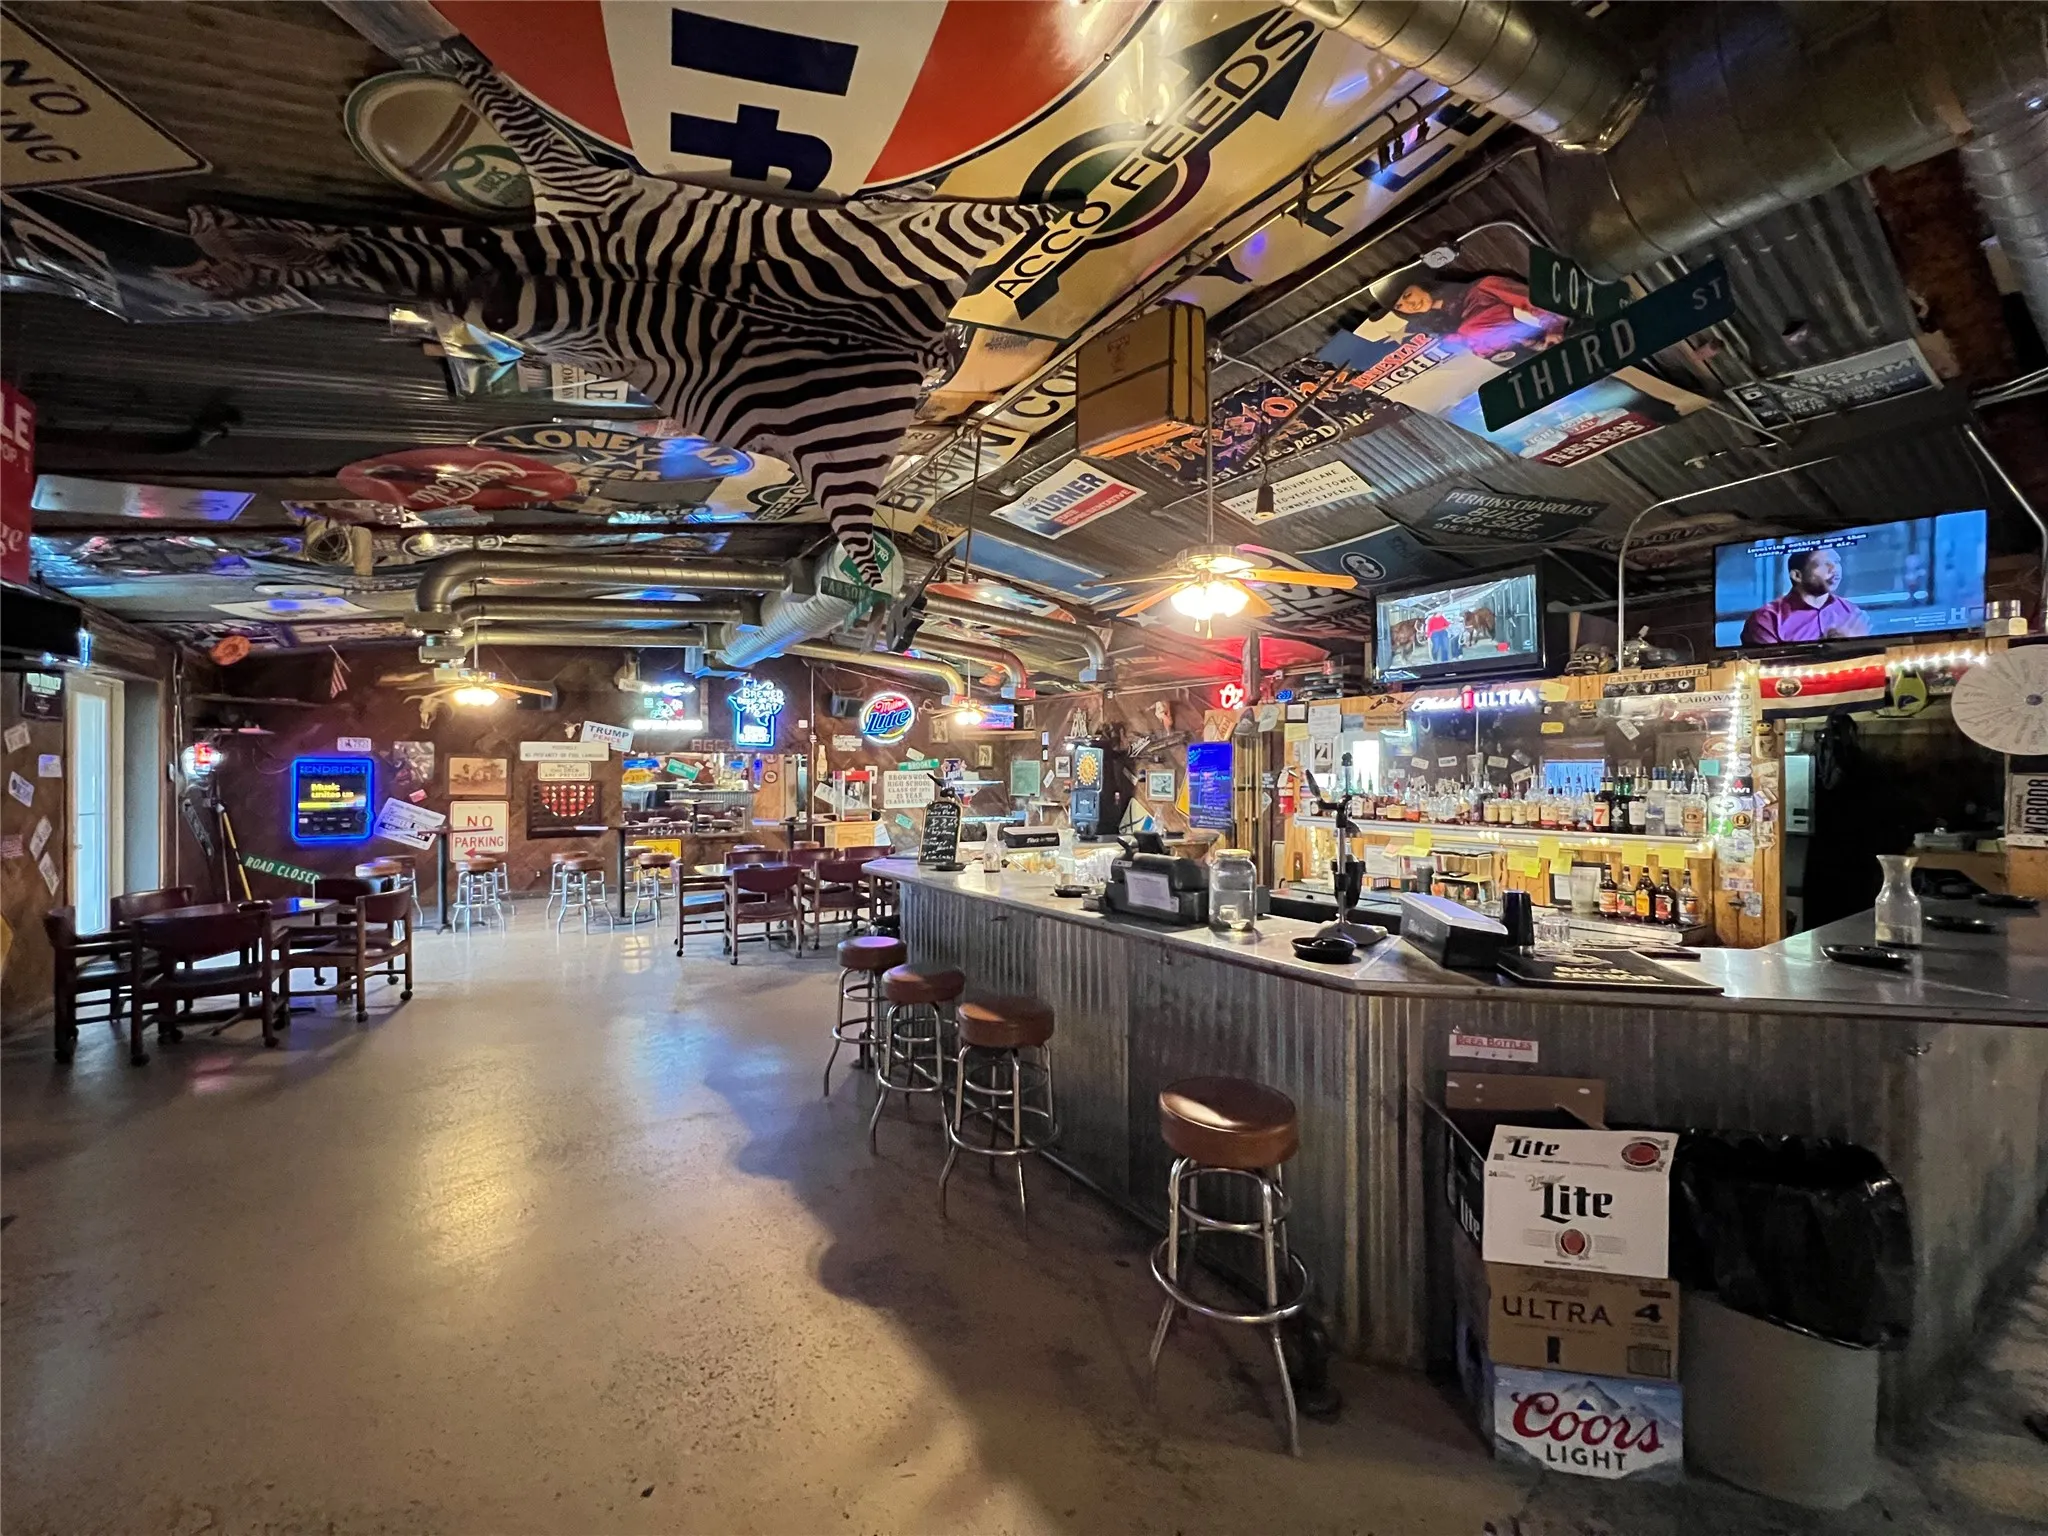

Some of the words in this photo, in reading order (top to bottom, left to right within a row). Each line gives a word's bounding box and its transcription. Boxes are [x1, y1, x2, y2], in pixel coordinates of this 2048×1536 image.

[0, 59, 91, 116] NO
[994, 201, 1112, 300] ACCO
[1110, 10, 1316, 192] FEEDS
[1551, 261, 1595, 315] COX
[1507, 318, 1637, 410] THIRD
[1691, 276, 1723, 311] ST
[1371, 340, 1455, 396] LIGHT
[503, 429, 637, 449] LONE
[1296, 433, 1318, 451] per
[556, 462, 662, 481] BEER
[885, 430, 1016, 513] BROWN
[1274, 477, 1313, 494] DRIVING
[1312, 469, 1340, 482] LANE
[1324, 475, 1359, 490] TOWED
[1029, 472, 1108, 517] TURNER
[1316, 485, 1358, 502] EXPENSE
[1061, 488, 1132, 526] REPRESENTATIVE
[1446, 492, 1511, 510] PERKINS
[1511, 498, 1599, 516] CHAROLAIS
[1438, 514, 1485, 527] FOR
[1470, 519, 1544, 532] SALE
[1468, 507, 1543, 523] BULLS
[1747, 543, 1786, 554] involving
[1643, 672, 1660, 680] FIX
[1665, 668, 1708, 678] STUPID
[742, 687, 784, 698] BREWED
[1474, 687, 1537, 708] ULTRA
[1678, 695, 1712, 704] CABO
[1713, 692, 1750, 704] WAO
[745, 702, 778, 713] HEART
[875, 697, 907, 713] Miller
[589, 724, 630, 738] TRUMP
[863, 709, 911, 736] Lite
[311, 782, 341, 792] Music
[311, 790, 341, 799] unites
[342, 791, 355, 799] us
[467, 815, 493, 828] NO
[1594, 808, 1607, 825] 7
[455, 835, 504, 849] PARKING
[245, 856, 274, 873] ROAD
[1456, 1034, 1484, 1047] BEER
[1486, 1037, 1533, 1050] BOTTLES
[1508, 1138, 1560, 1159] Lite
[1540, 1181, 1613, 1224] Lite
[1502, 1295, 1615, 1328] ULTRA
[1635, 1303, 1663, 1323] 4
[1511, 1391, 1665, 1454] Coors
[1546, 1444, 1628, 1471] LIGHT
